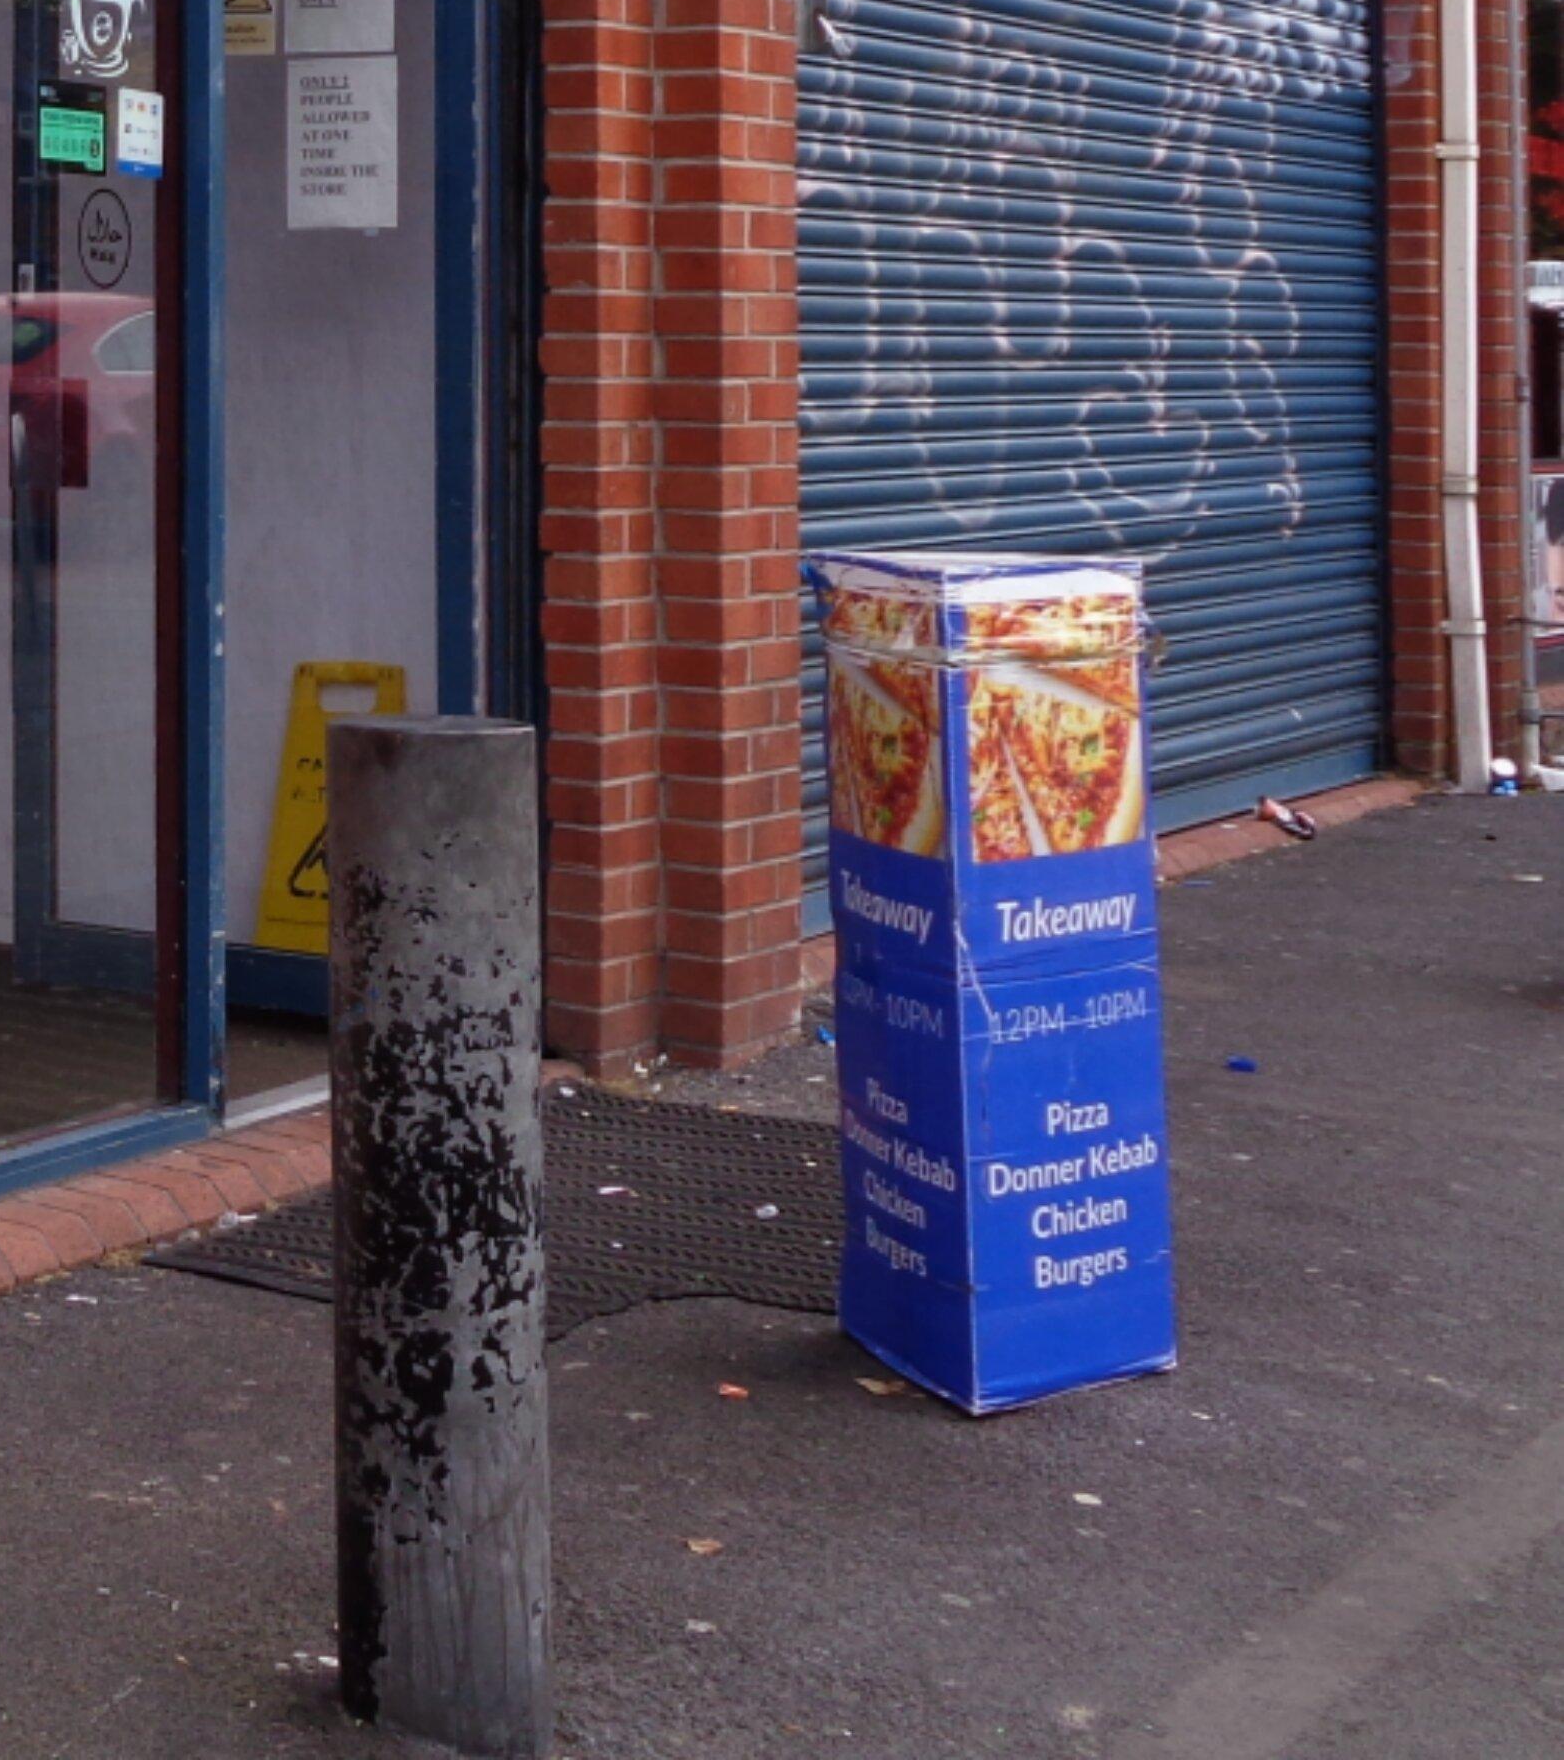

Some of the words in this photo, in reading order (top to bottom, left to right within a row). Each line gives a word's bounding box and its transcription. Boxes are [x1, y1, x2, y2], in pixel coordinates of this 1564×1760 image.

[299, 93, 353, 106] PEOPLE
[839, 868, 933, 946] Takeaway
[995, 893, 1137, 943] Takeaway
[887, 993, 944, 1039] 10PM
[991, 1002, 1065, 1044] 12PM
[1085, 988, 1146, 1029] 10PM
[866, 1076, 908, 1126] Pizza
[1046, 1101, 1109, 1136] Pizza
[843, 1107, 890, 1164] Donner
[893, 1137, 956, 1192] Kebab
[988, 1157, 1085, 1197] Donner
[1089, 1133, 1159, 1178] Kebab
[864, 1170, 927, 1229] Chicken
[1032, 1196, 1128, 1238] Chicken
[866, 1216, 927, 1277] Burgers
[1035, 1247, 1128, 1289] Burgers
